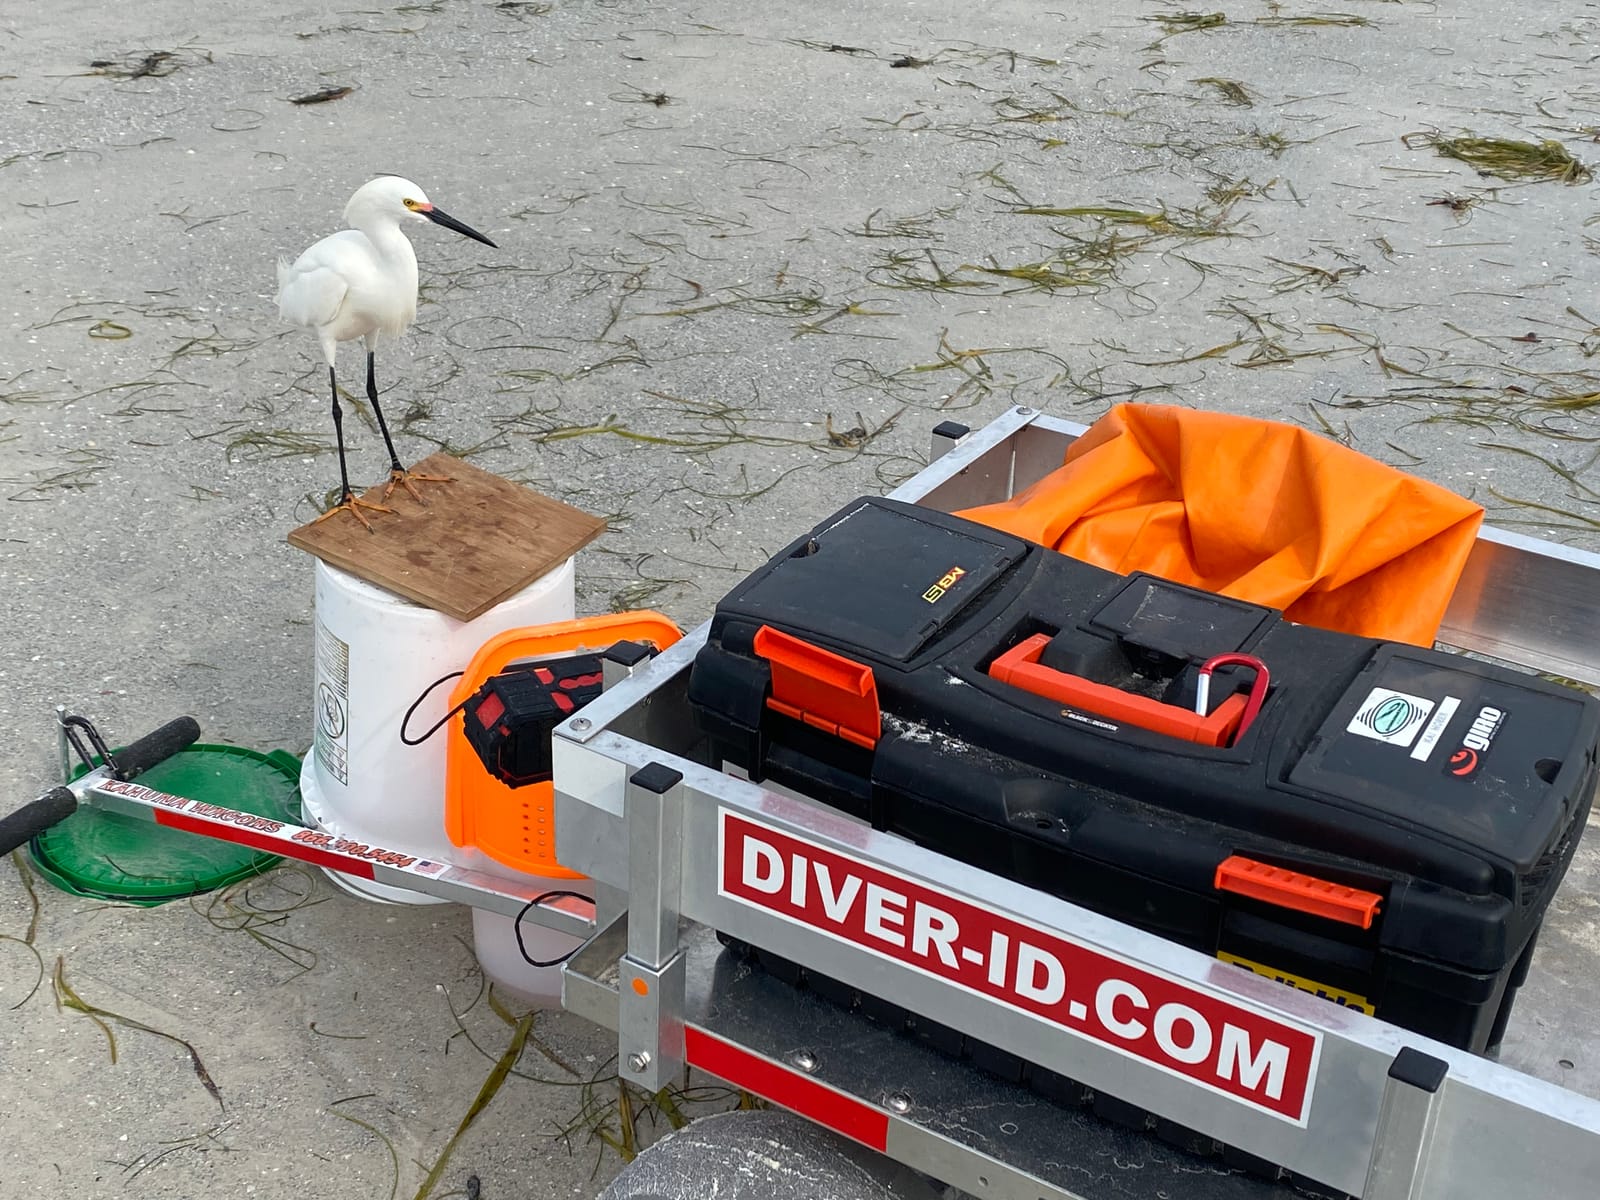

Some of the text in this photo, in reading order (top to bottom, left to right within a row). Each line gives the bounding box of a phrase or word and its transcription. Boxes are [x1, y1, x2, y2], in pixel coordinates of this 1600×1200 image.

[98, 780, 190, 810] KAHUNA
[188, 801, 285, 833] WAGONS
[741, 835, 1290, 1101] DIVER-ID.COM
